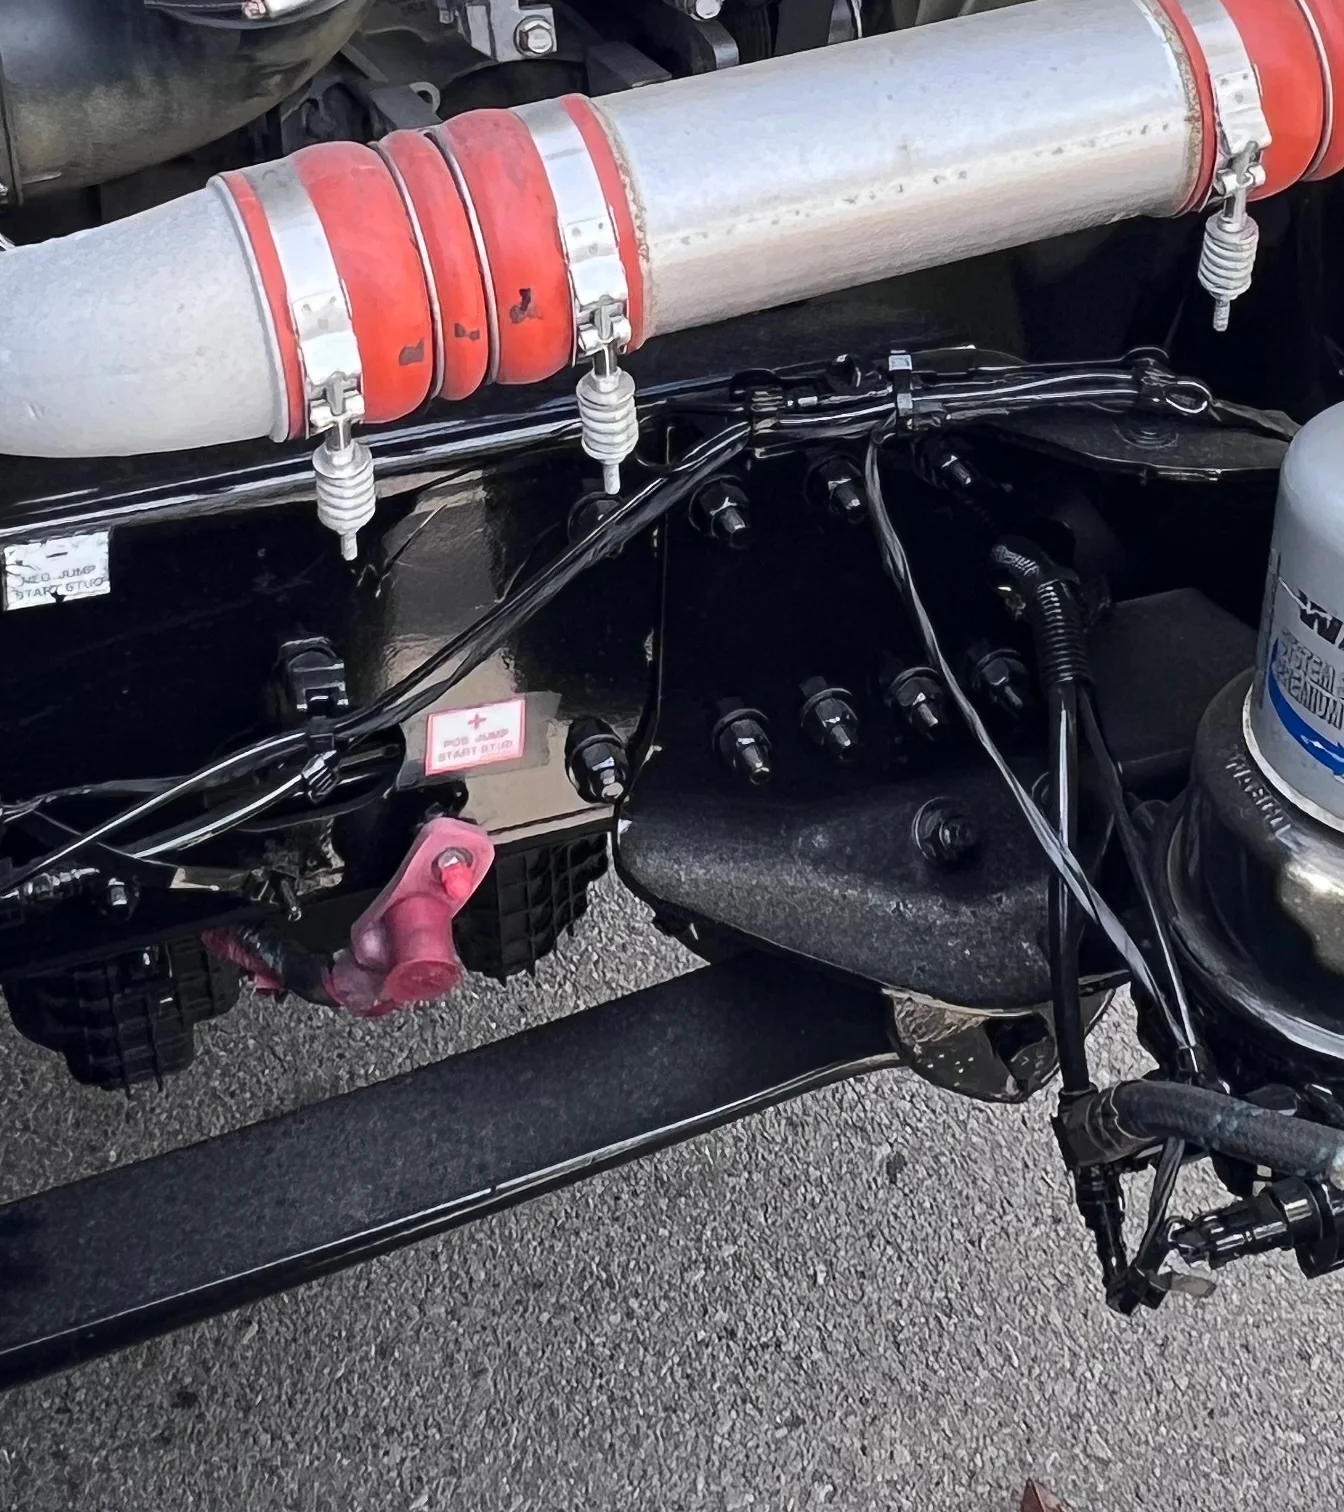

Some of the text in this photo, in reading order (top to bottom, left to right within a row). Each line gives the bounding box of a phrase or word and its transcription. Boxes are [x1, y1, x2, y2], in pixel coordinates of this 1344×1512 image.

[58, 565, 96, 580] JUMP
[14, 583, 63, 601] START
[437, 746, 478, 763] START
